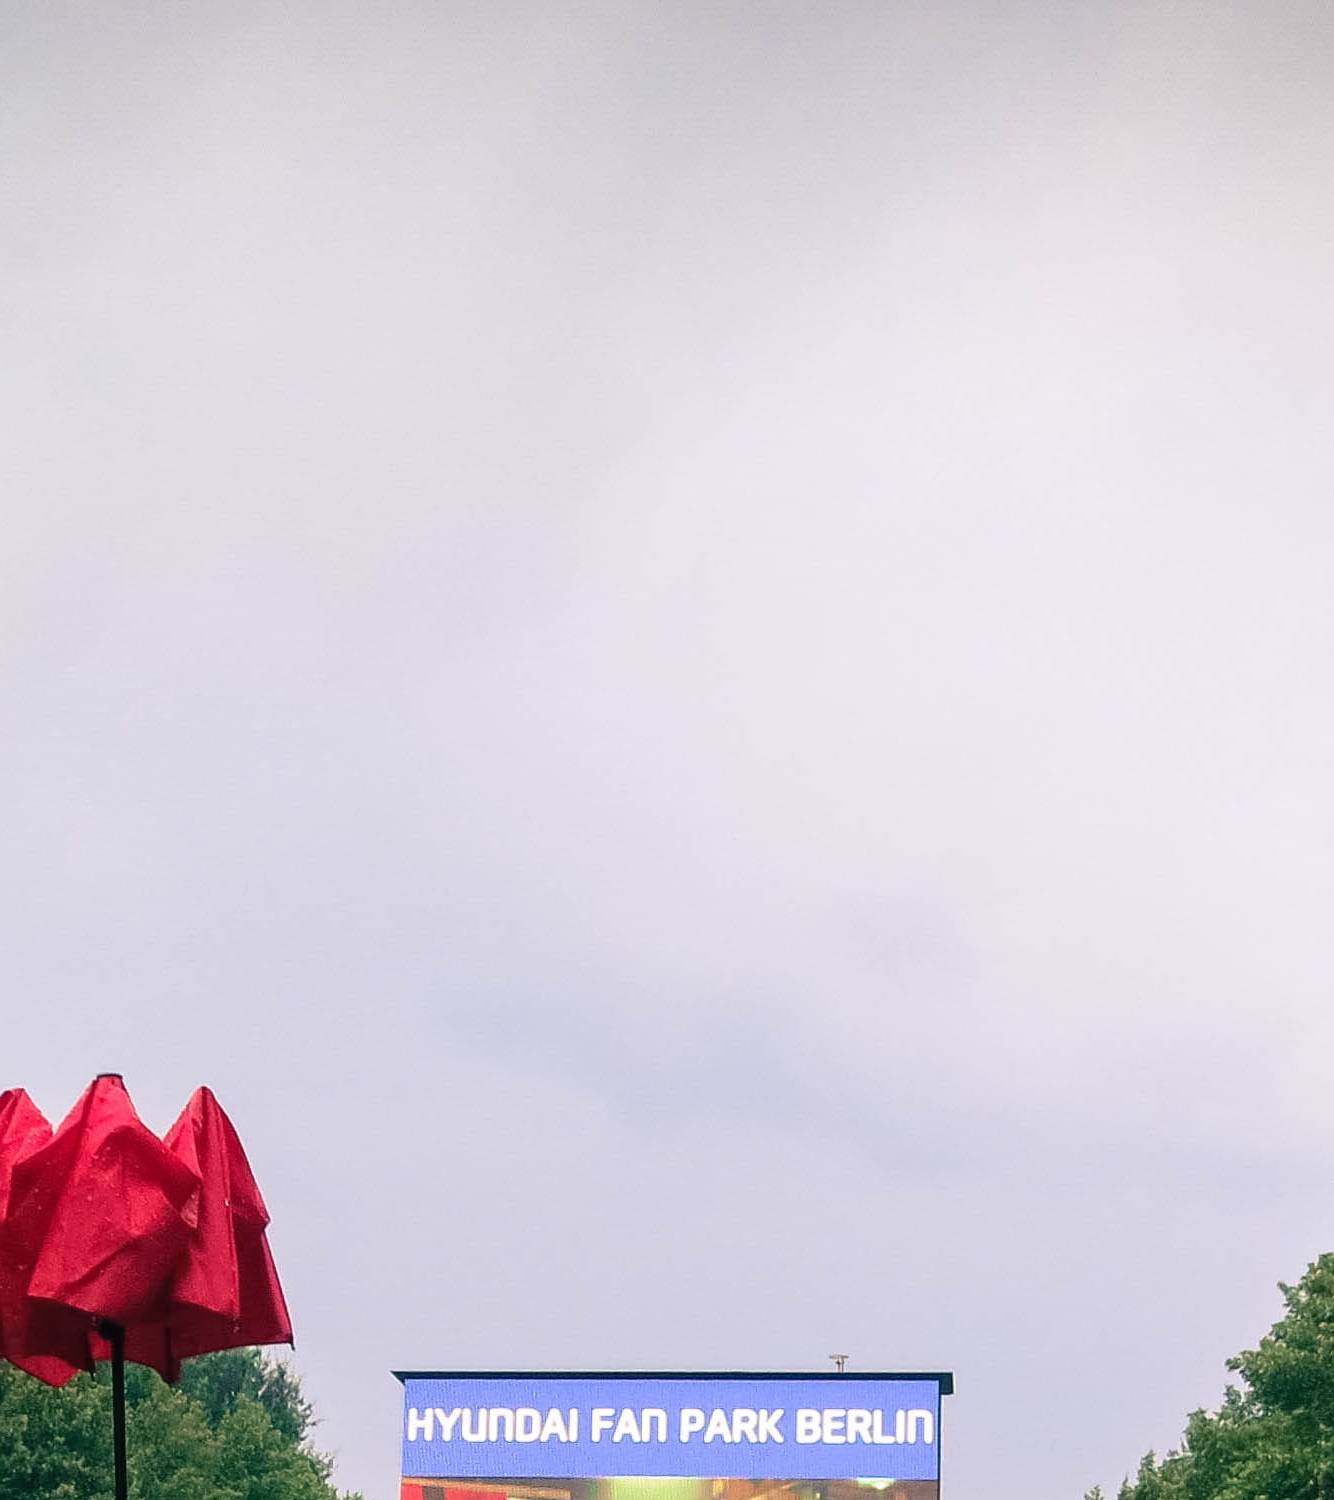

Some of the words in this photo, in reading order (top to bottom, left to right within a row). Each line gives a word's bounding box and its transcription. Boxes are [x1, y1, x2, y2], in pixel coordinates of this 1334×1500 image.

[407, 1407, 579, 1443] HYUNDAI
[591, 1408, 667, 1443] FAN
[679, 1408, 785, 1444] PARK
[795, 1408, 935, 1445] BERLIN
